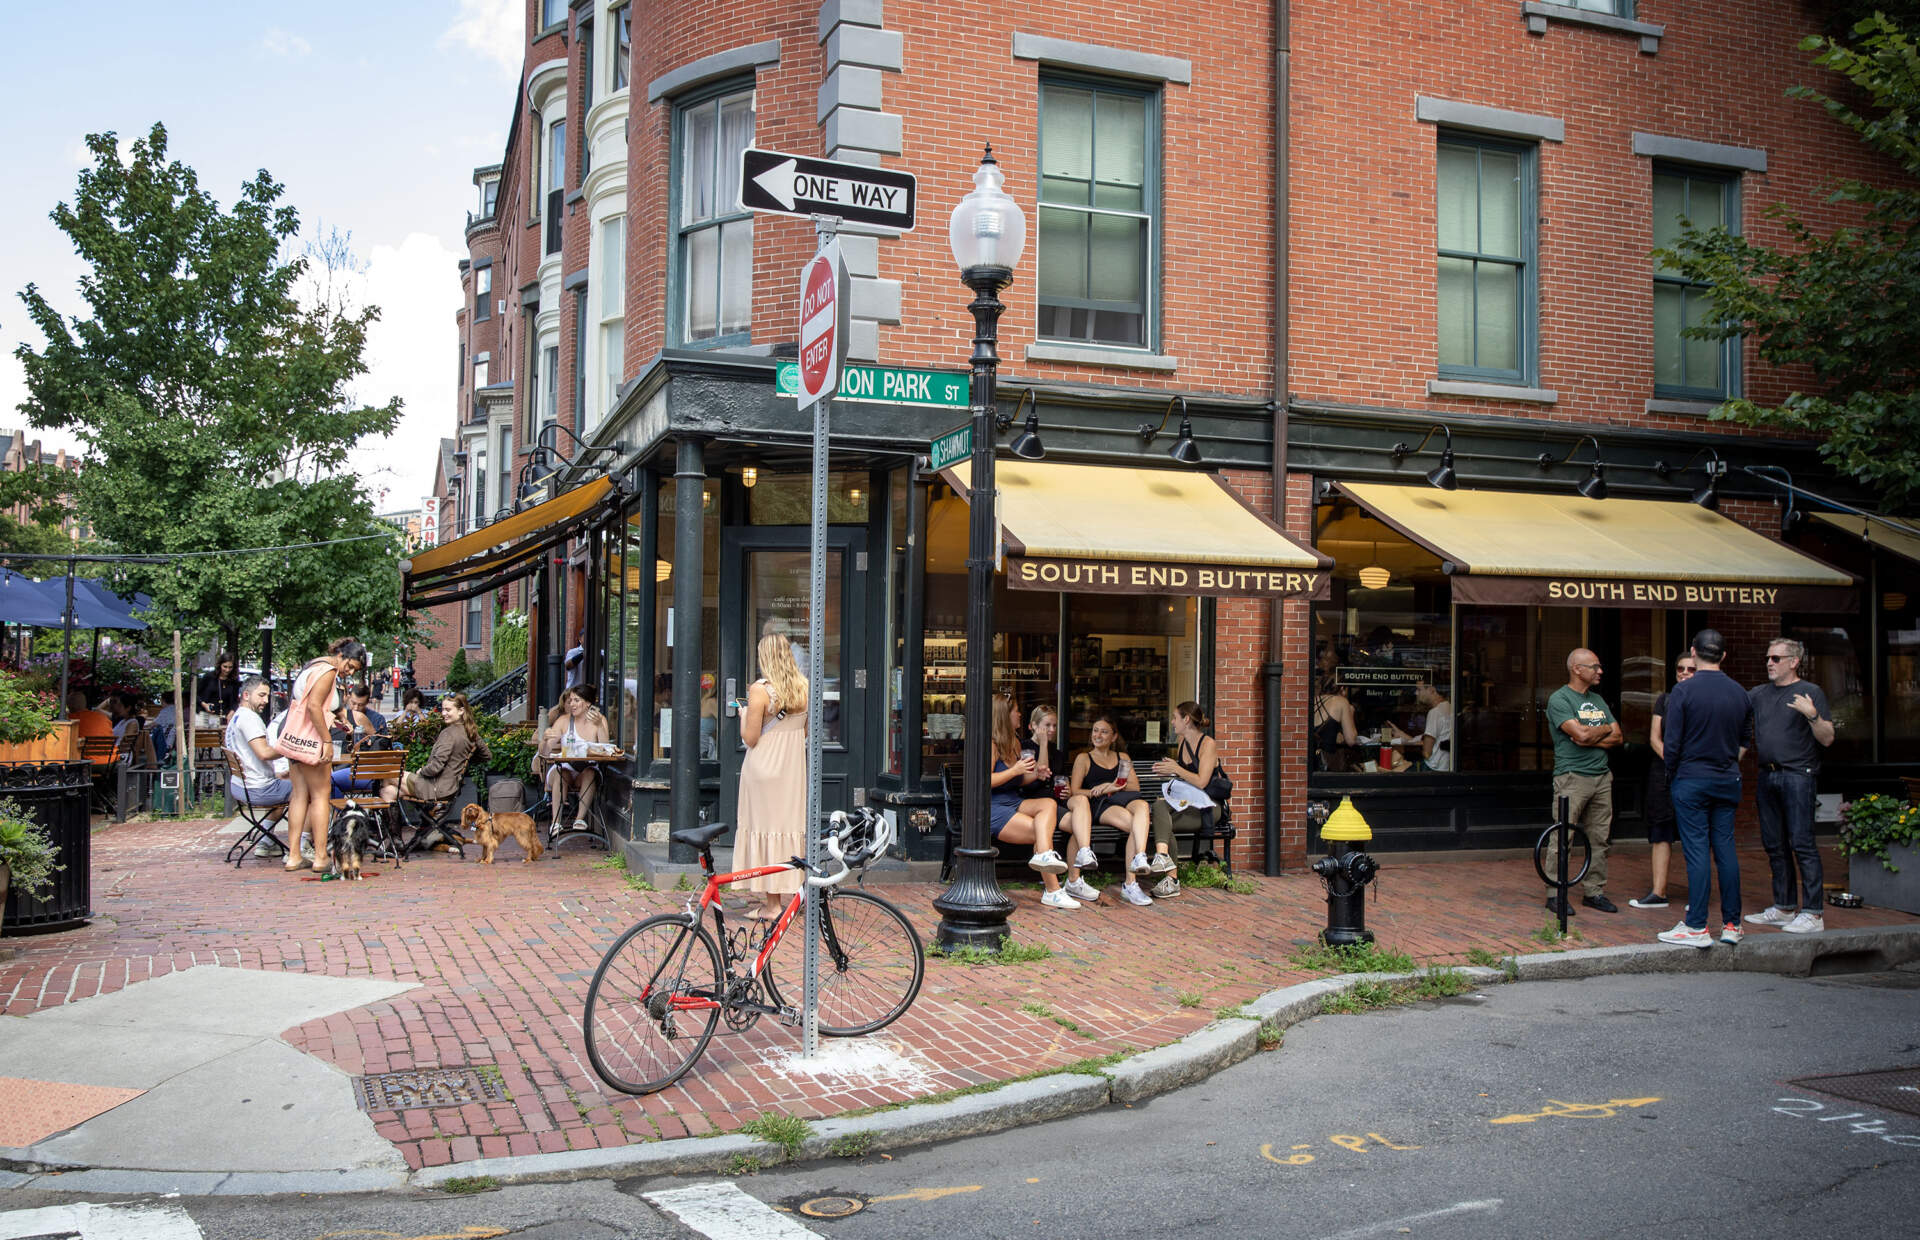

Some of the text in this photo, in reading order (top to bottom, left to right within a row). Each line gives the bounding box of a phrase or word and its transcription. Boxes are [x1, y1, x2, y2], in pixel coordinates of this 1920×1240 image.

[794, 175, 898, 209] ONE WAY
[804, 277, 831, 319] DO NOT
[805, 337, 828, 370] ENTER
[838, 368, 960, 401] ION PARK ST
[940, 430, 970, 463] SHAWMUT
[1021, 562, 1319, 593] SOUTH END BUTTERY
[1548, 581, 1778, 604] SOUTH END BUTTERY
[1390, 673, 1424, 681] BUTTERY
[284, 732, 319, 749] LICENSE
